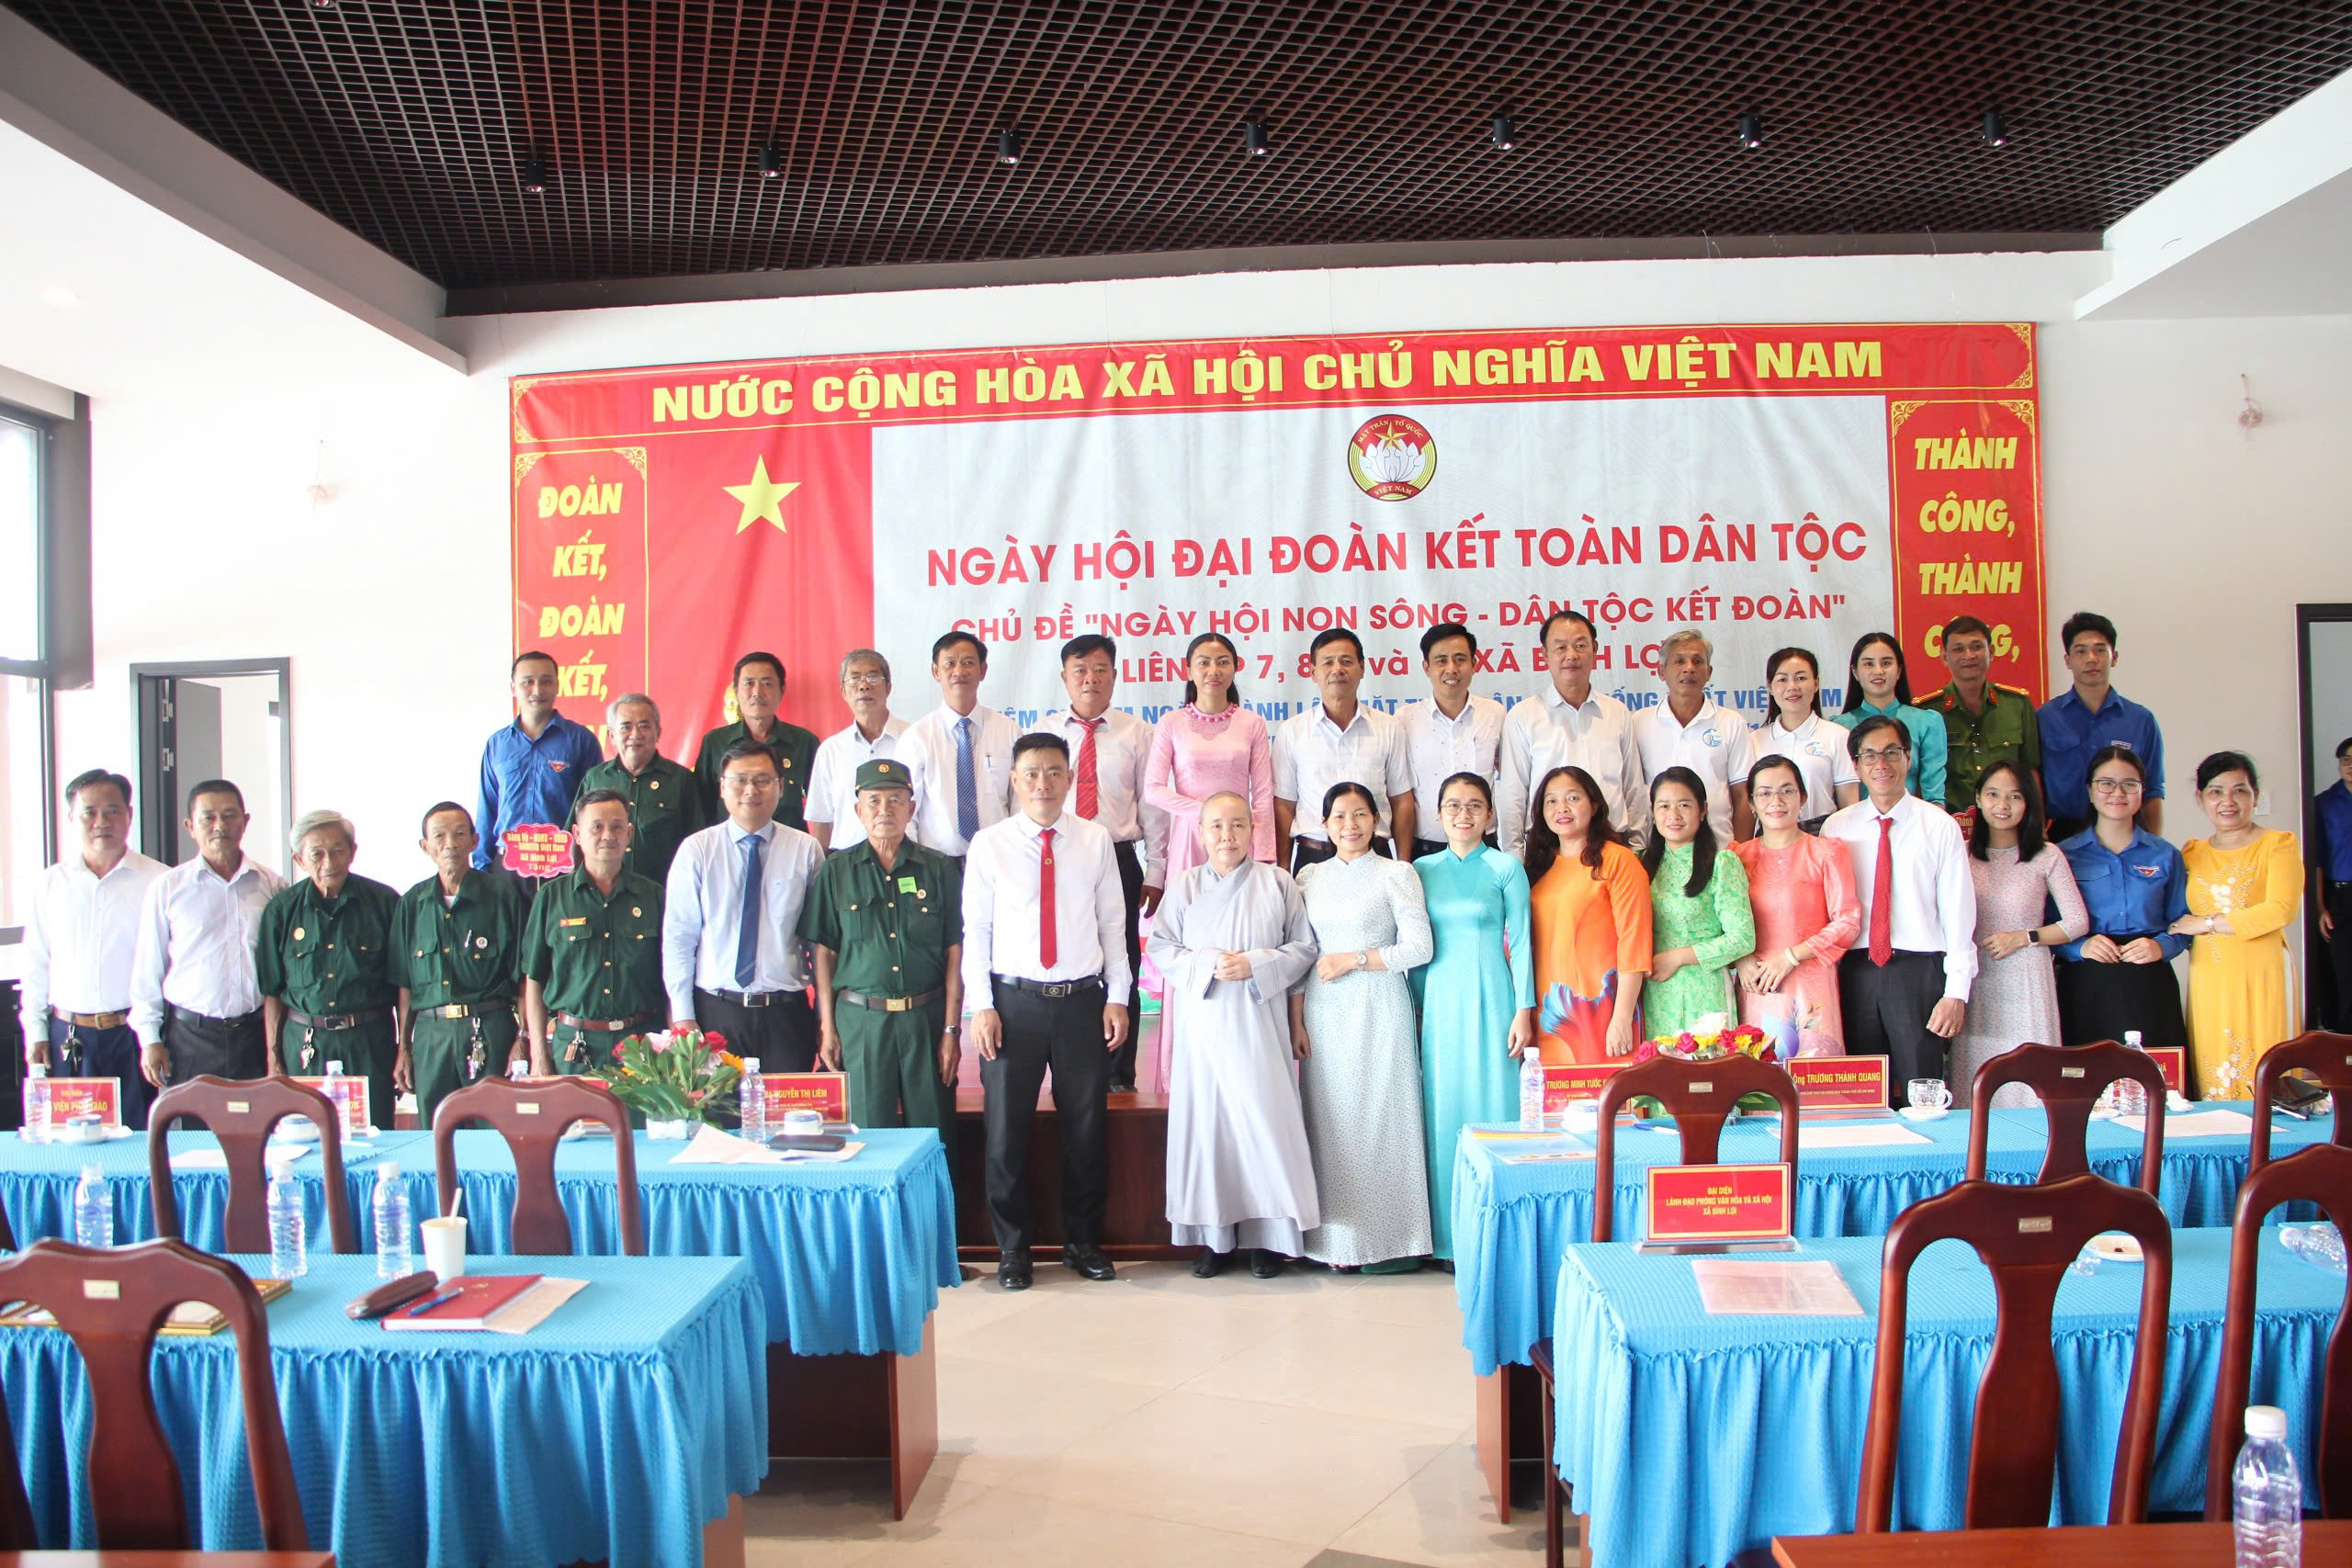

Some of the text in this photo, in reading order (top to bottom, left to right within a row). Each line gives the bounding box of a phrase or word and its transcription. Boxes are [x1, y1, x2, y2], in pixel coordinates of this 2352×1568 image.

[653, 335, 1883, 423] NƯỚC CỘNG HÒA XÃ HỘI CHỦ NGHĨA VIỆT NAM
[1914, 427, 2018, 470] THÀNH
[538, 475, 623, 518] ĐOÀN
[1919, 491, 2015, 537] CÔNG,
[553, 529, 607, 581] KẾT,
[928, 512, 1867, 591] NGÀY HỘI ĐẠI ĐOÀN KẾT TOÀN DÂN TỘC
[1918, 552, 2022, 594] THÀNH
[539, 595, 625, 637] ĐOÀN
[1034, 602, 1073, 640] ĐỀ
[1086, 604, 1197, 637] "NGÀY
[1209, 602, 1270, 641] HỘI
[1283, 605, 1358, 632] NON
[1369, 597, 1468, 630] SÔNG
[1582, 592, 1654, 631] TỘC
[1667, 584, 1721, 622] KẾT
[1732, 586, 1846, 620] ĐOÀN"
[1122, 650, 1188, 683] LIÊN
[1368, 649, 1409, 676] và
[1474, 642, 1521, 673] XÃ
[1924, 626, 2019, 662] CG,
[557, 649, 607, 702] KẾT,
[1571, 1079, 1585, 1089] MINH
[1858, 1072, 1881, 1082] QUANG
